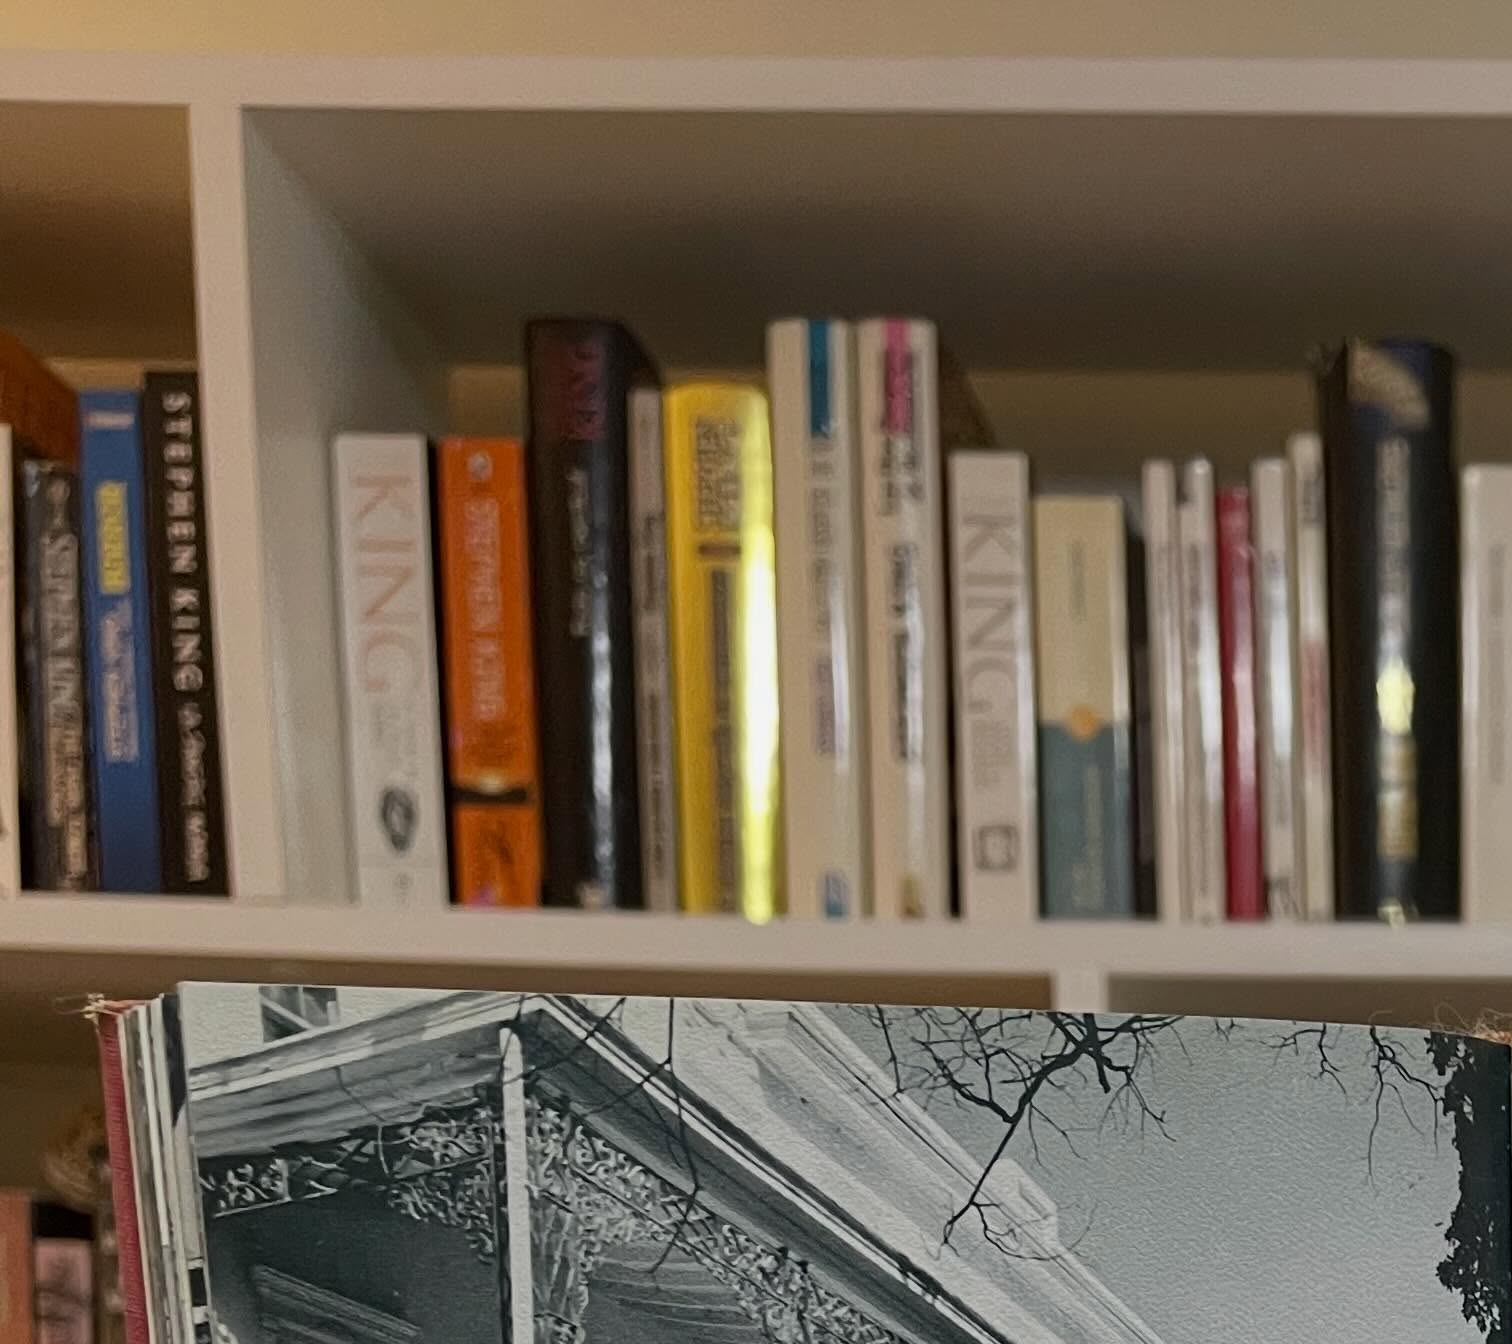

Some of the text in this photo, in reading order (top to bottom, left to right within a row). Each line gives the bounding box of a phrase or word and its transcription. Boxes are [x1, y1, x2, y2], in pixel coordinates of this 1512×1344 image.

[163, 391, 199, 575] STEPHEN
[169, 586, 205, 694] KING
[349, 474, 426, 693] KING
[962, 514, 1023, 716] KING
